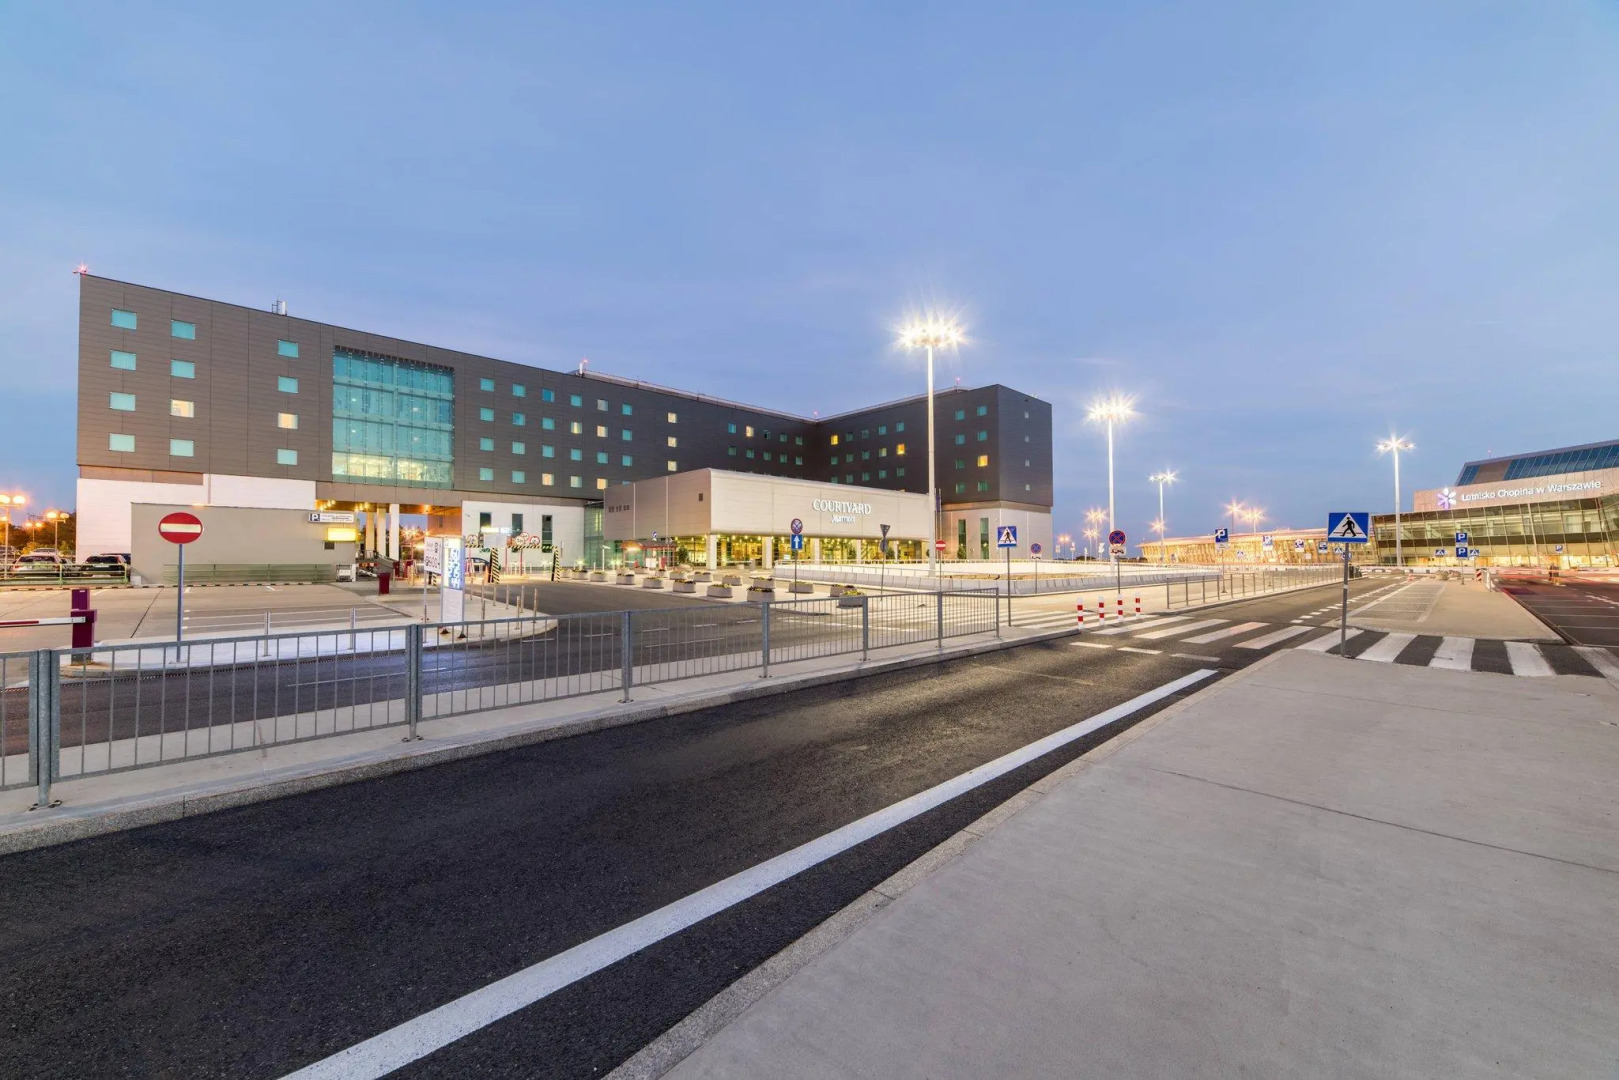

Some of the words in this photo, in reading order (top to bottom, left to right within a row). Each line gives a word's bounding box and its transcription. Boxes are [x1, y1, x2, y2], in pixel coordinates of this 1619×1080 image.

[1461, 491, 1496, 502] Lotnisko
[1497, 487, 1534, 499] Chopina
[1548, 481, 1602, 493] Warszawie
[813, 499, 871, 515] COURTYARD
